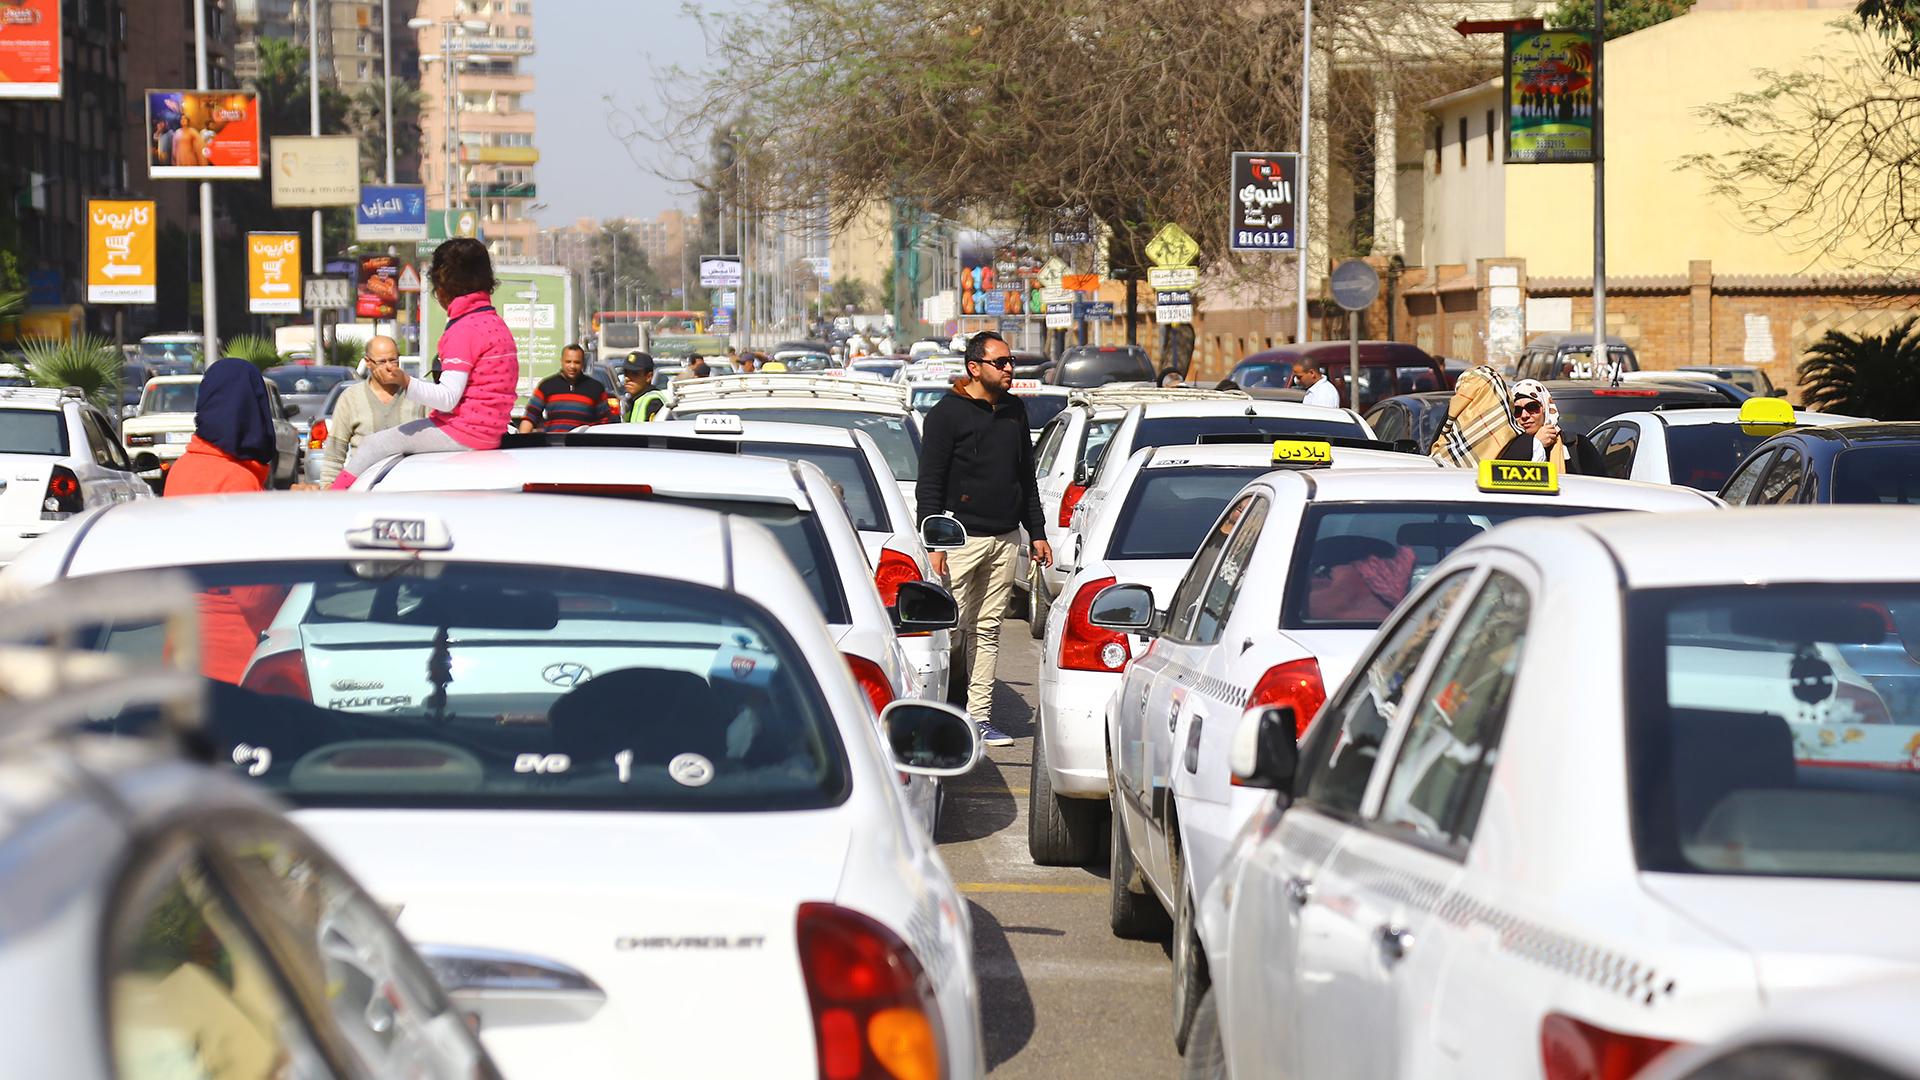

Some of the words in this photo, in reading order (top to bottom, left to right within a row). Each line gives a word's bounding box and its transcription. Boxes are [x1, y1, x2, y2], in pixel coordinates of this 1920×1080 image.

[1239, 181, 1292, 208] النبوي
[93, 207, 148, 229] كازيون
[254, 239, 296, 256] كازيون
[1498, 466, 1541, 481] TAXI
[375, 520, 422, 540] TAXI
[329, 695, 412, 709] HYUNDAI
[514, 753, 571, 774] DVD
[614, 935, 765, 951] CHEVROLET
